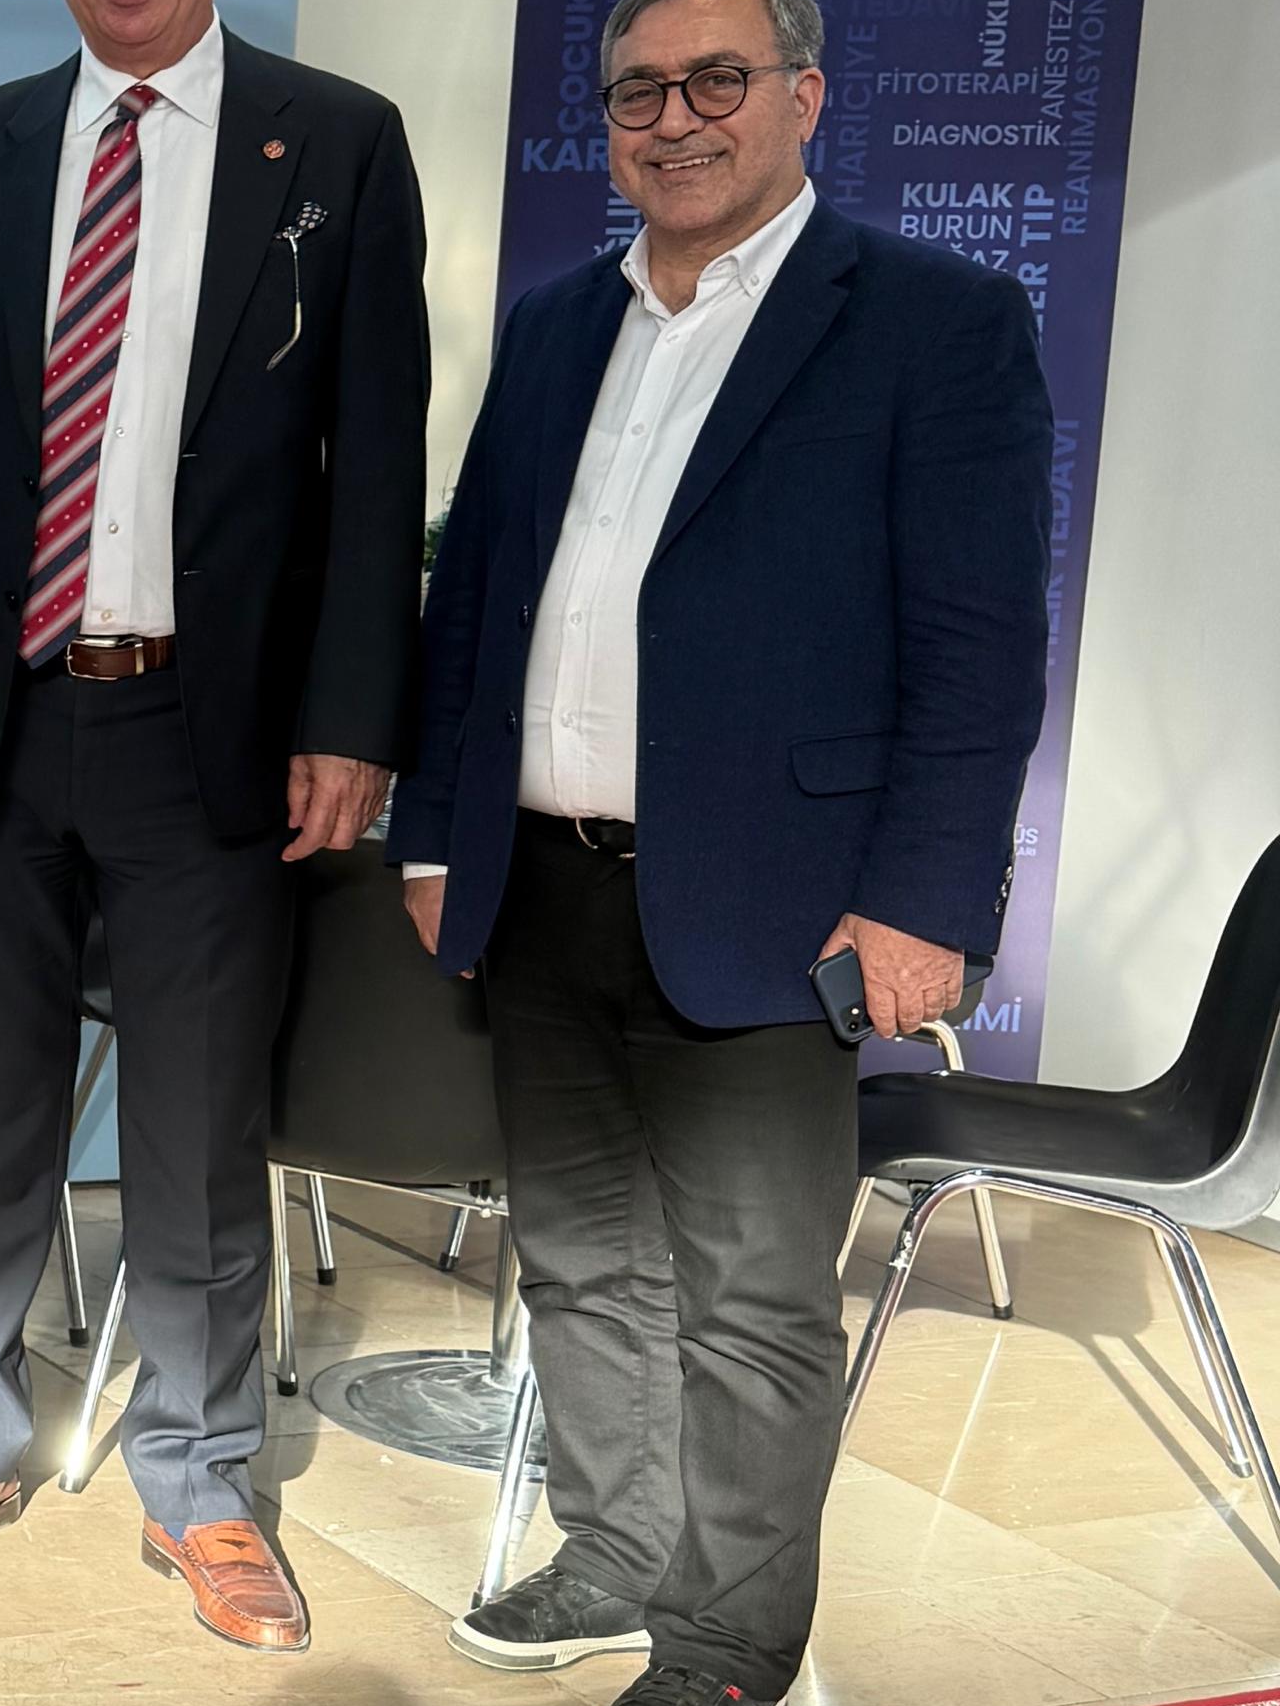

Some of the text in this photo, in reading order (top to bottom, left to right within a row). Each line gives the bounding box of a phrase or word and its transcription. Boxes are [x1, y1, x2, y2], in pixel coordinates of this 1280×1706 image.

[875, 66, 1039, 94] FİTOTERAPİ
[832, 23, 879, 204] HARİCİYE
[893, 119, 1063, 146] DİAGNOSTİK
[901, 182, 1016, 208] KULAK
[900, 214, 1013, 240] BURUN
[1019, 182, 1056, 249] TIP
